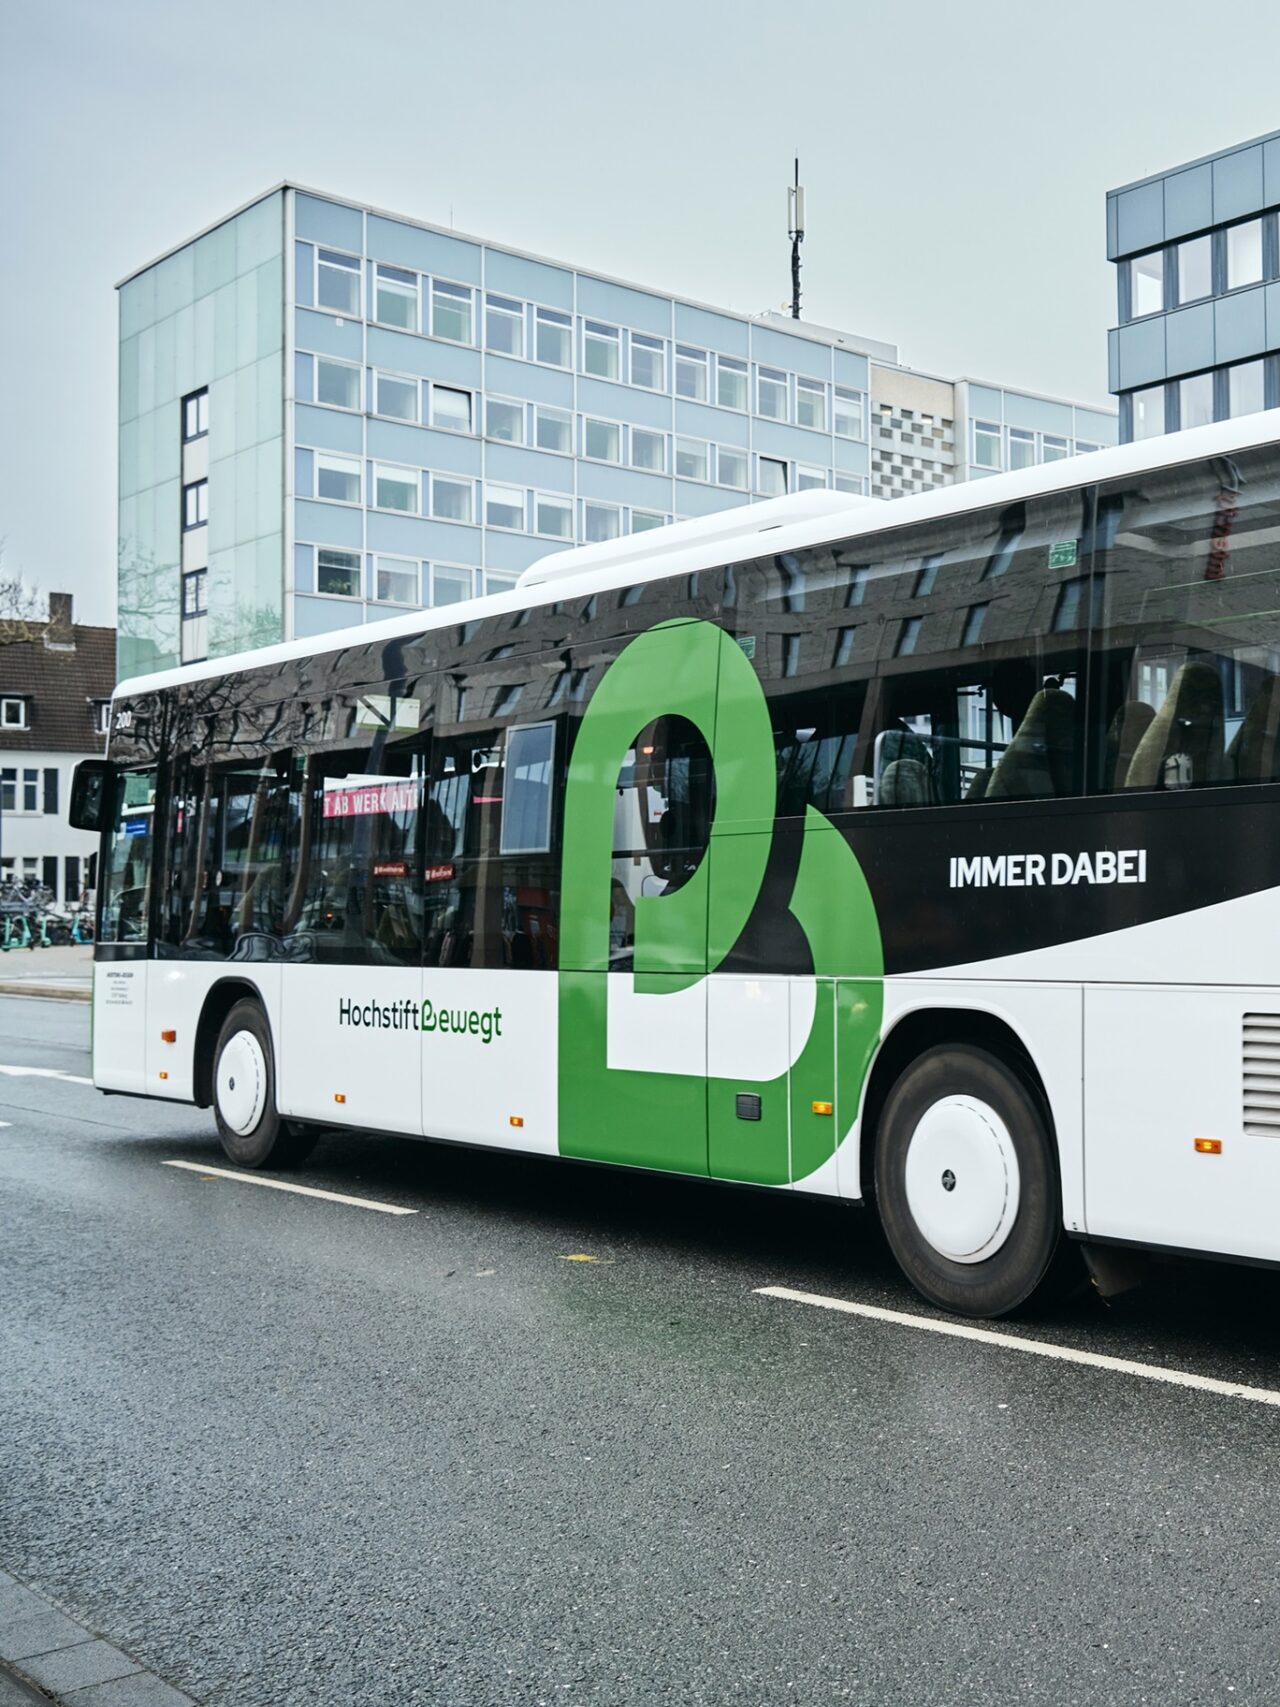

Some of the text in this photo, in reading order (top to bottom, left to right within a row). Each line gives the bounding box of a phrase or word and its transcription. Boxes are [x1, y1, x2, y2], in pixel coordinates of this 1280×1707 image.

[115, 710, 132, 729] 200
[334, 795, 349, 816] AB
[353, 790, 386, 813] WERK
[950, 850, 1146, 887] IMMER DABEI
